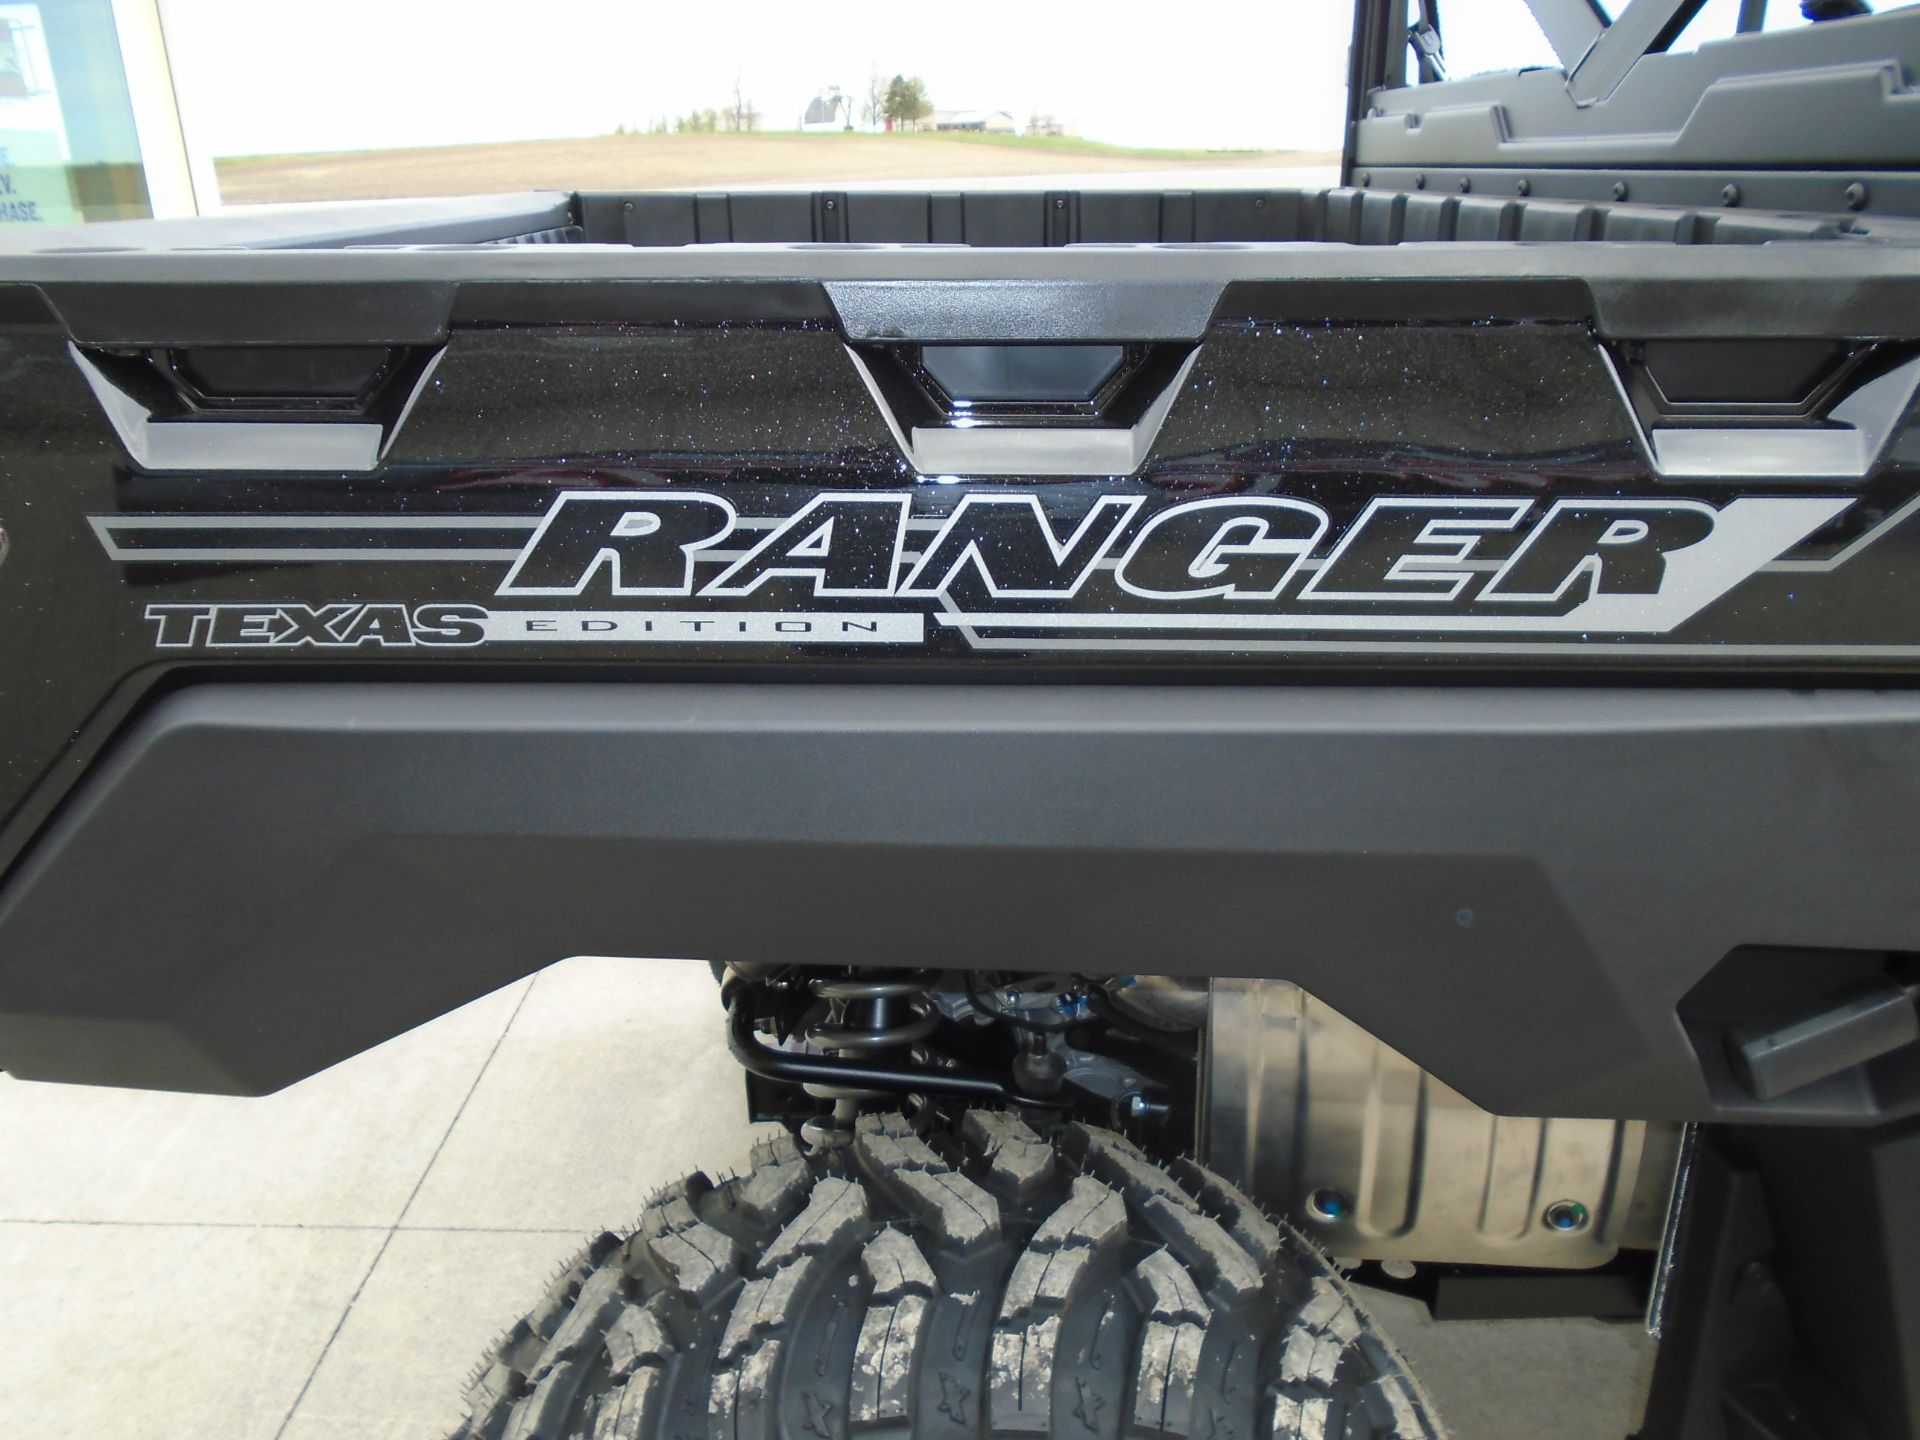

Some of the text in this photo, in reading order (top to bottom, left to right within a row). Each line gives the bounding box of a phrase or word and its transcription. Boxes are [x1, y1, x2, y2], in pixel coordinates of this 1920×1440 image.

[494, 490, 1717, 604] RANGER
[144, 603, 878, 647] TEXAS EDITION
